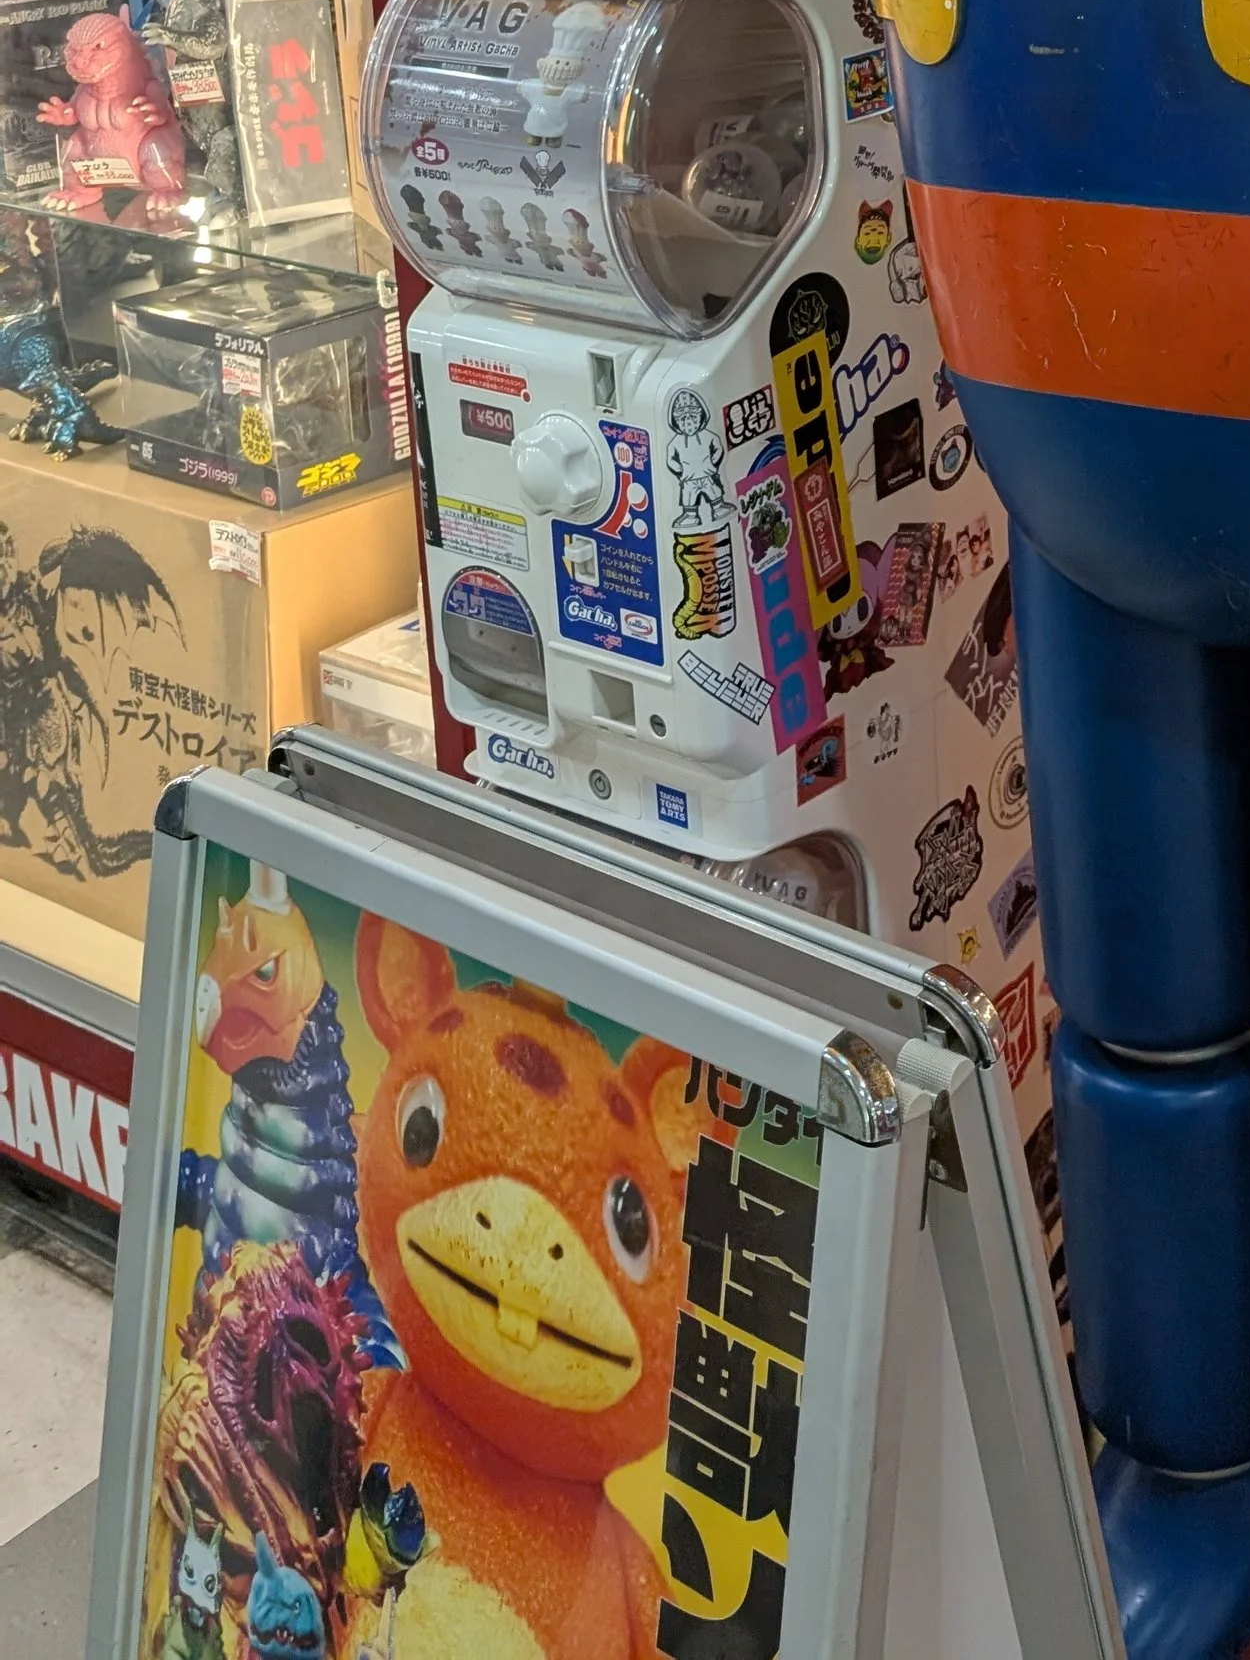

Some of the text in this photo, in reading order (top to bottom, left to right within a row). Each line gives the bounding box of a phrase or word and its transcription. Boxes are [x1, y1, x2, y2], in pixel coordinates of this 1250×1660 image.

[476, 409, 513, 432] ¥500
[178, 457, 238, 486] ゴジラ(1999)
[600, 543, 654, 565] コインを入れてから
[600, 556, 643, 574] ハンドルを右に
[128, 665, 257, 736] 東宝大怪獣シリーズ
[112, 695, 257, 775] デストロイア
[659, 799, 685, 813] TOMY
